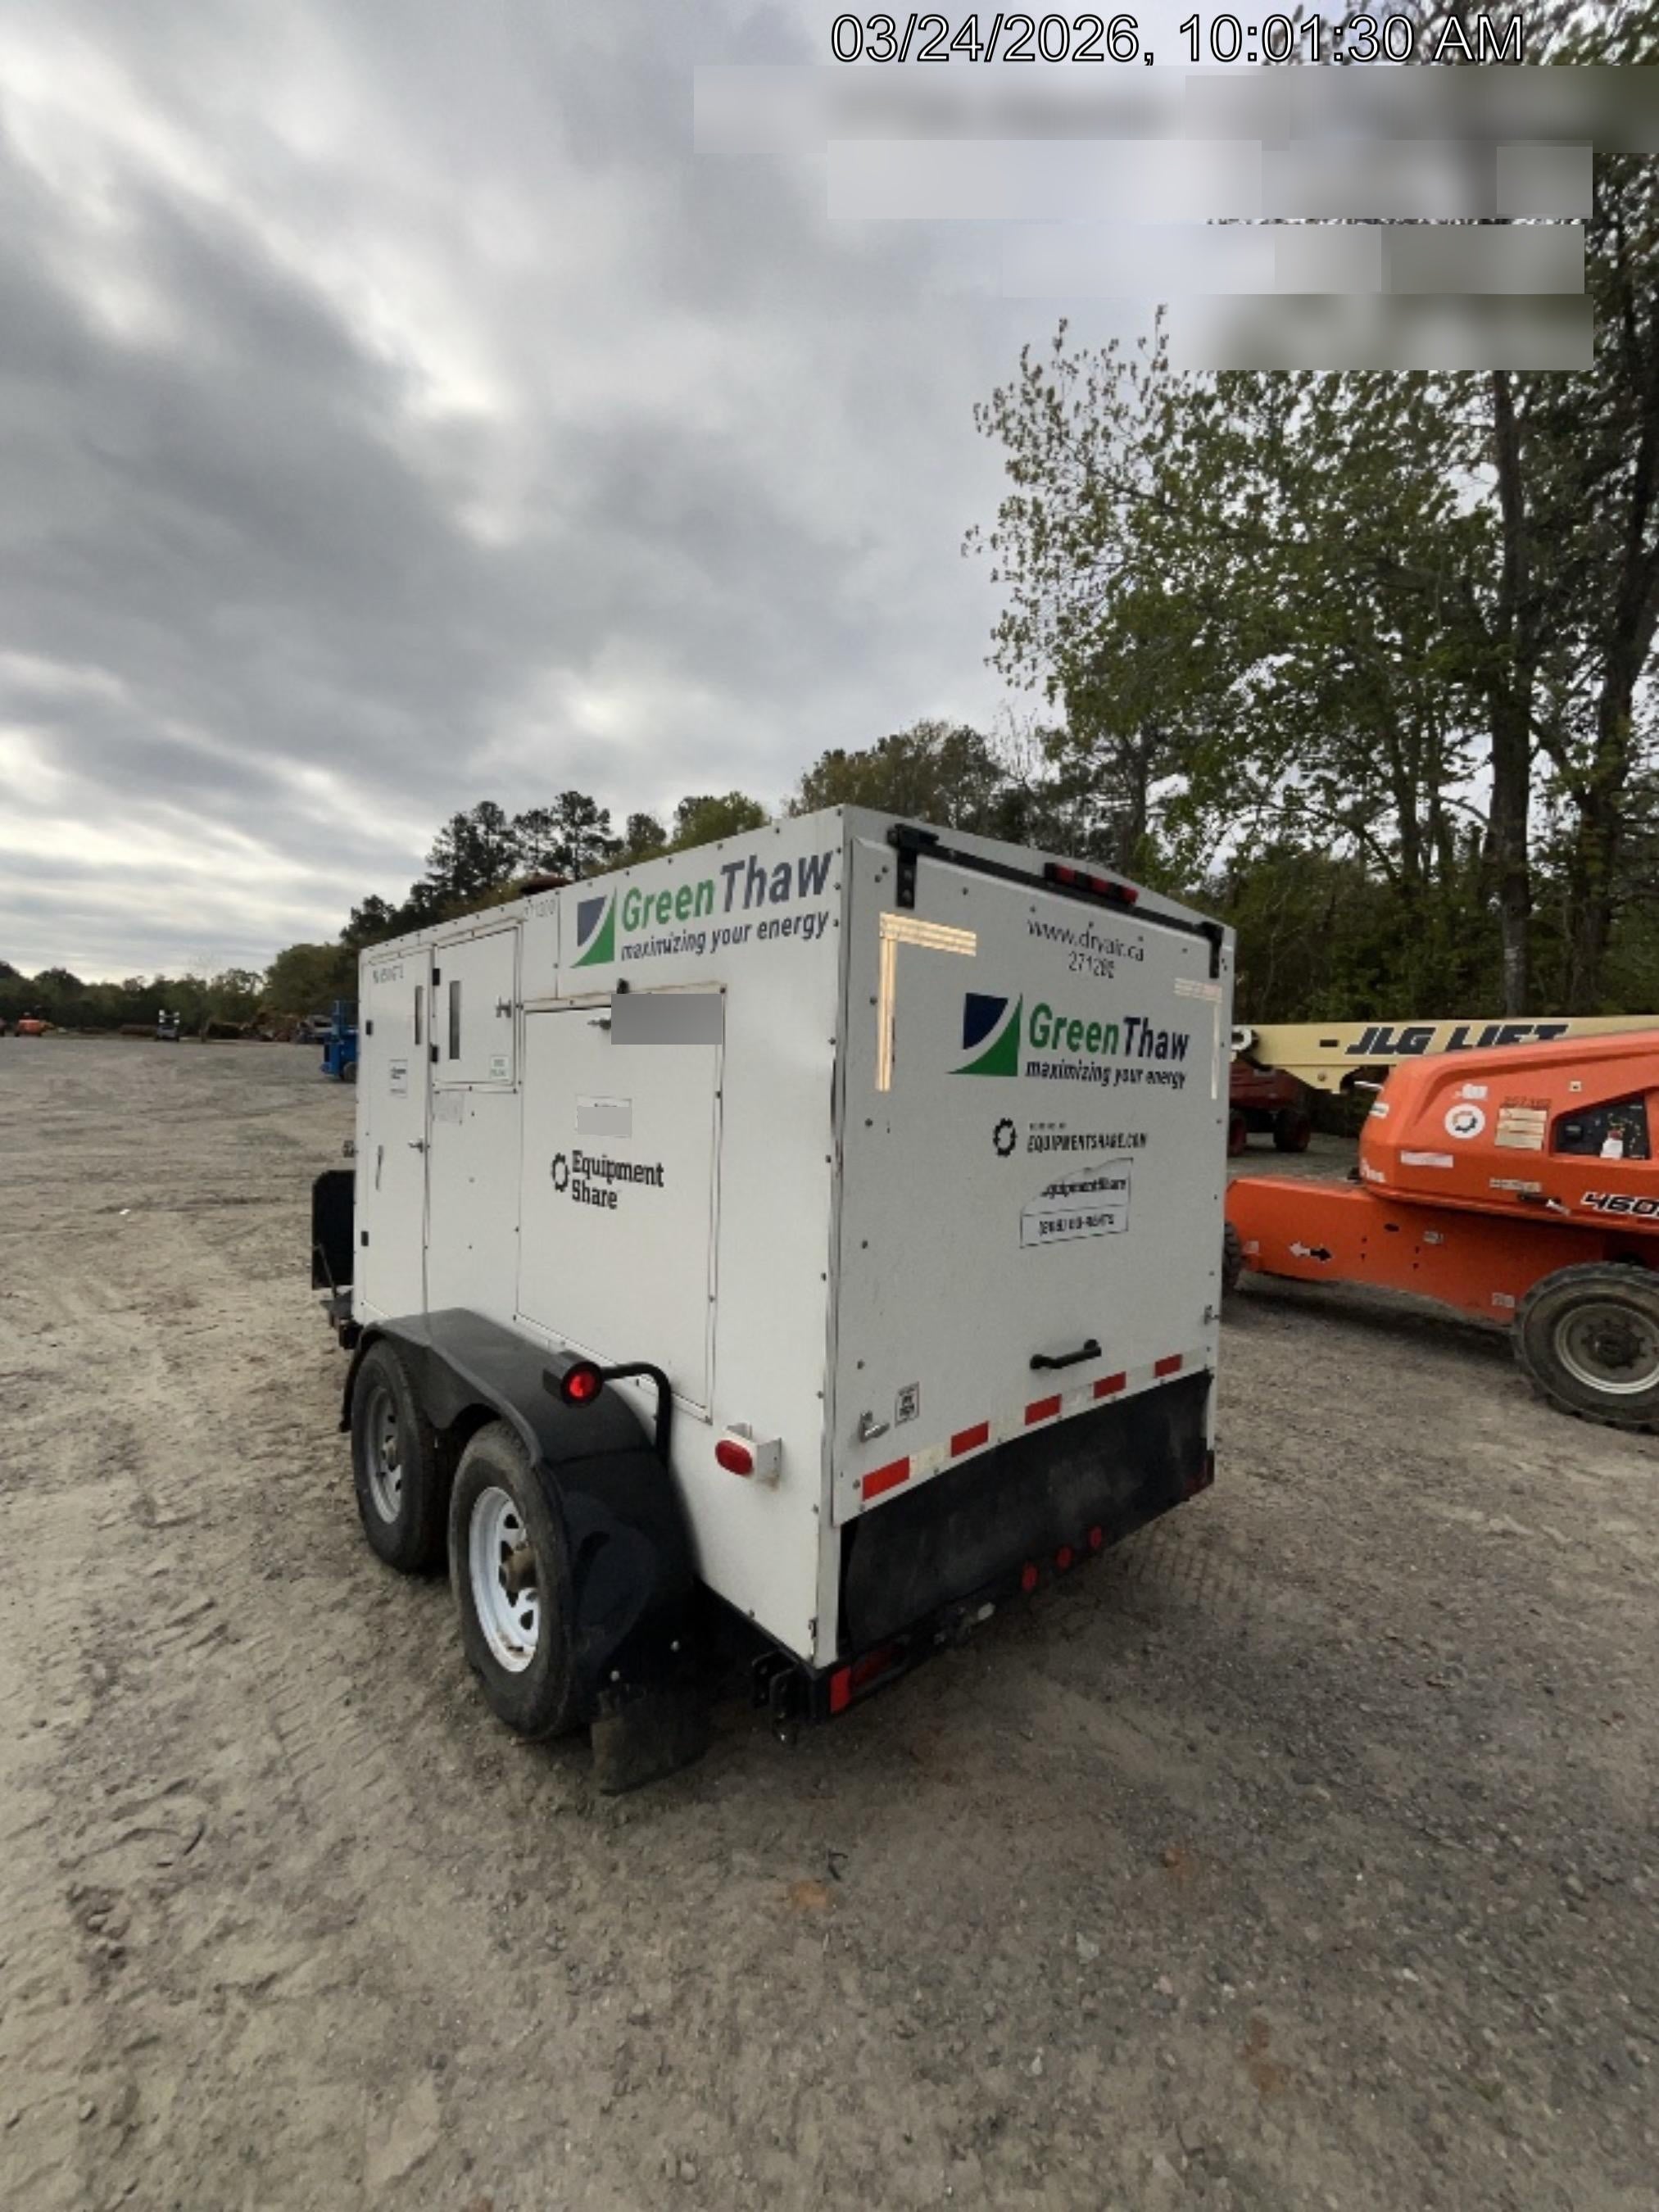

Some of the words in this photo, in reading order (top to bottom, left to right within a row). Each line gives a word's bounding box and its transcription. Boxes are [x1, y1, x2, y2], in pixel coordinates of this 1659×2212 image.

[621, 929, 706, 961] maximizing
[711, 923, 751, 954] your
[756, 911, 830, 941] energy
[1029, 1003, 1190, 1062] GreenThaw
[1345, 1027, 1436, 1054] JLG
[1444, 1024, 1569, 1052] LIFT
[1025, 1059, 1110, 1087] maximizing
[1113, 1067, 1143, 1087] your
[1146, 1070, 1186, 1090] energy
[572, 1149, 664, 1188] Equipment
[572, 1179, 618, 1210] Share
[1580, 1191, 1659, 1221] 460
